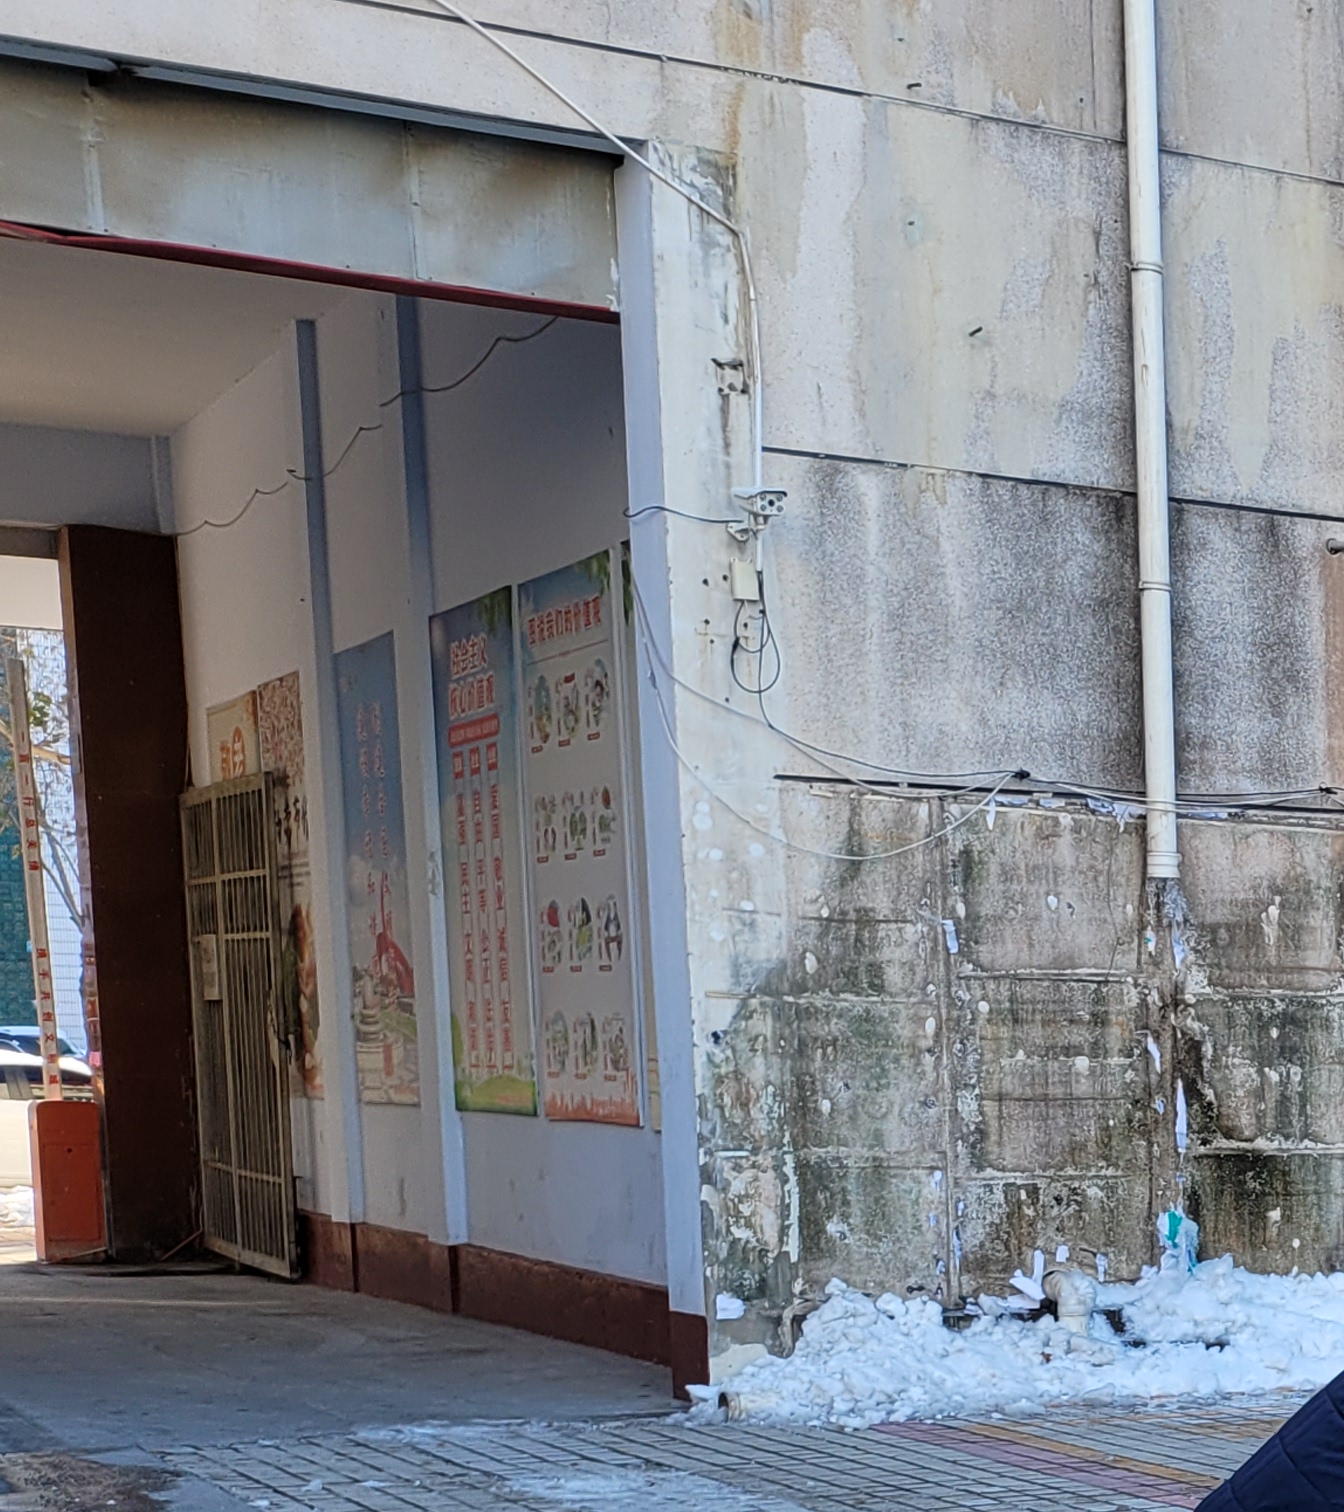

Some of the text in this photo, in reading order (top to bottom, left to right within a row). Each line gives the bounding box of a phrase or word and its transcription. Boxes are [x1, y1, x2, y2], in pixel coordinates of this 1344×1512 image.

[451, 632, 489, 680] 社会主义
[449, 673, 495, 721] 核心价值观
